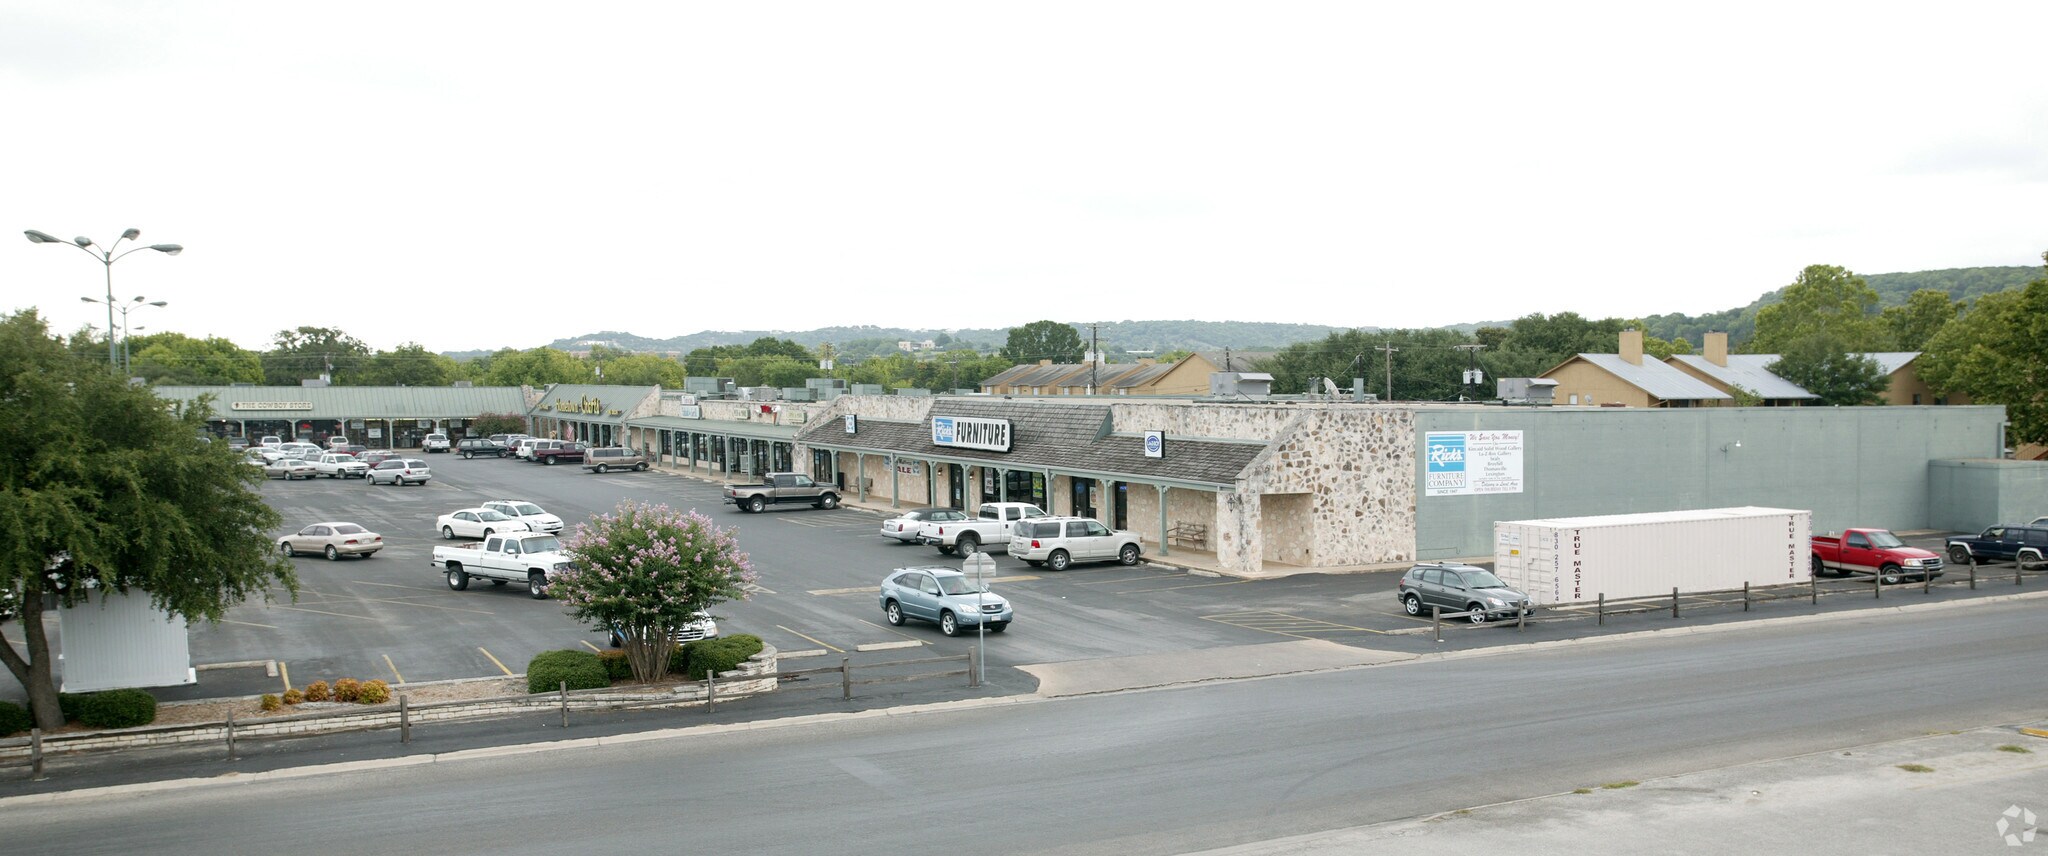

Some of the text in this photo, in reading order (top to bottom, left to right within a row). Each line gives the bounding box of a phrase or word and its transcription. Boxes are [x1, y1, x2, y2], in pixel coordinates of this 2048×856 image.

[956, 421, 1006, 446] FURNITURE
[1788, 543, 1796, 579] MASTER
[1574, 560, 1582, 599] MASTER
